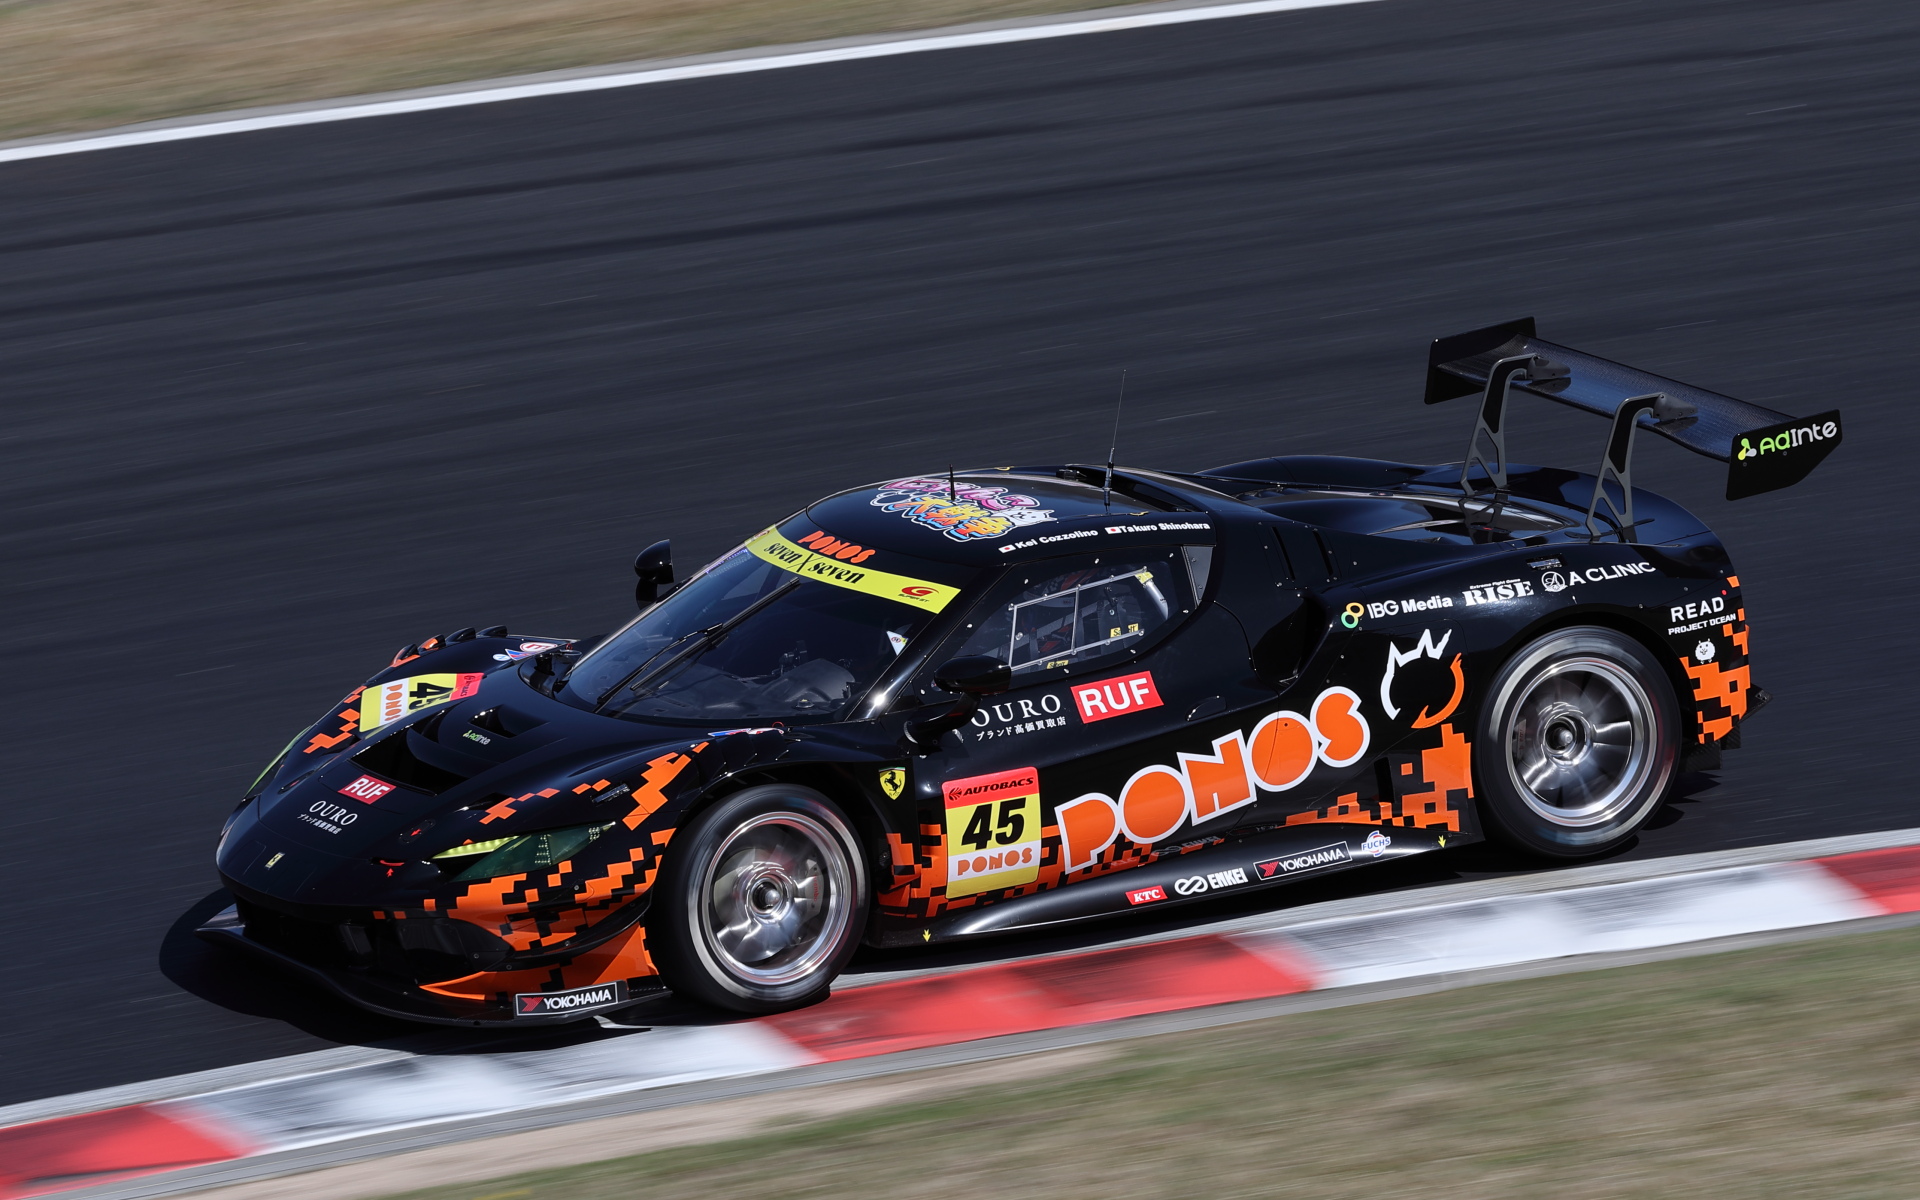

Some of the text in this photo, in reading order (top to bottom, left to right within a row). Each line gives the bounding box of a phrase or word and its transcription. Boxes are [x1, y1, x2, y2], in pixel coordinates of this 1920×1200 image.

[1759, 421, 1838, 455] AdInte
[1014, 529, 1098, 549] Kei Cozzolino
[1119, 522, 1210, 533] Takuro Shinohara
[797, 530, 876, 563] PONOS
[763, 542, 803, 564] seven
[808, 561, 866, 584] seven
[1569, 561, 1656, 586] A CLINIC
[1462, 581, 1534, 607] RISE
[1366, 595, 1453, 619] IBG Media
[1670, 597, 1725, 622] READ
[1668, 620, 1708, 635] PROJECT
[1078, 677, 1150, 717] RUF
[970, 694, 1061, 727] OURO
[976, 716, 1067, 742] ブランド高価買取店
[344, 777, 391, 799] RUF
[963, 776, 1034, 797] AUTOBACS
[1054, 686, 1371, 875] PONOS
[309, 800, 358, 826] OURO
[960, 797, 1027, 850] 45
[1362, 837, 1390, 851] FUCHS
[957, 847, 1033, 876] PONOS
[1278, 848, 1345, 872] YOKOHAMA
[1207, 868, 1248, 890] ENKEI
[1133, 889, 1161, 903] KTC
[543, 988, 612, 1010] YOKOHAMA
